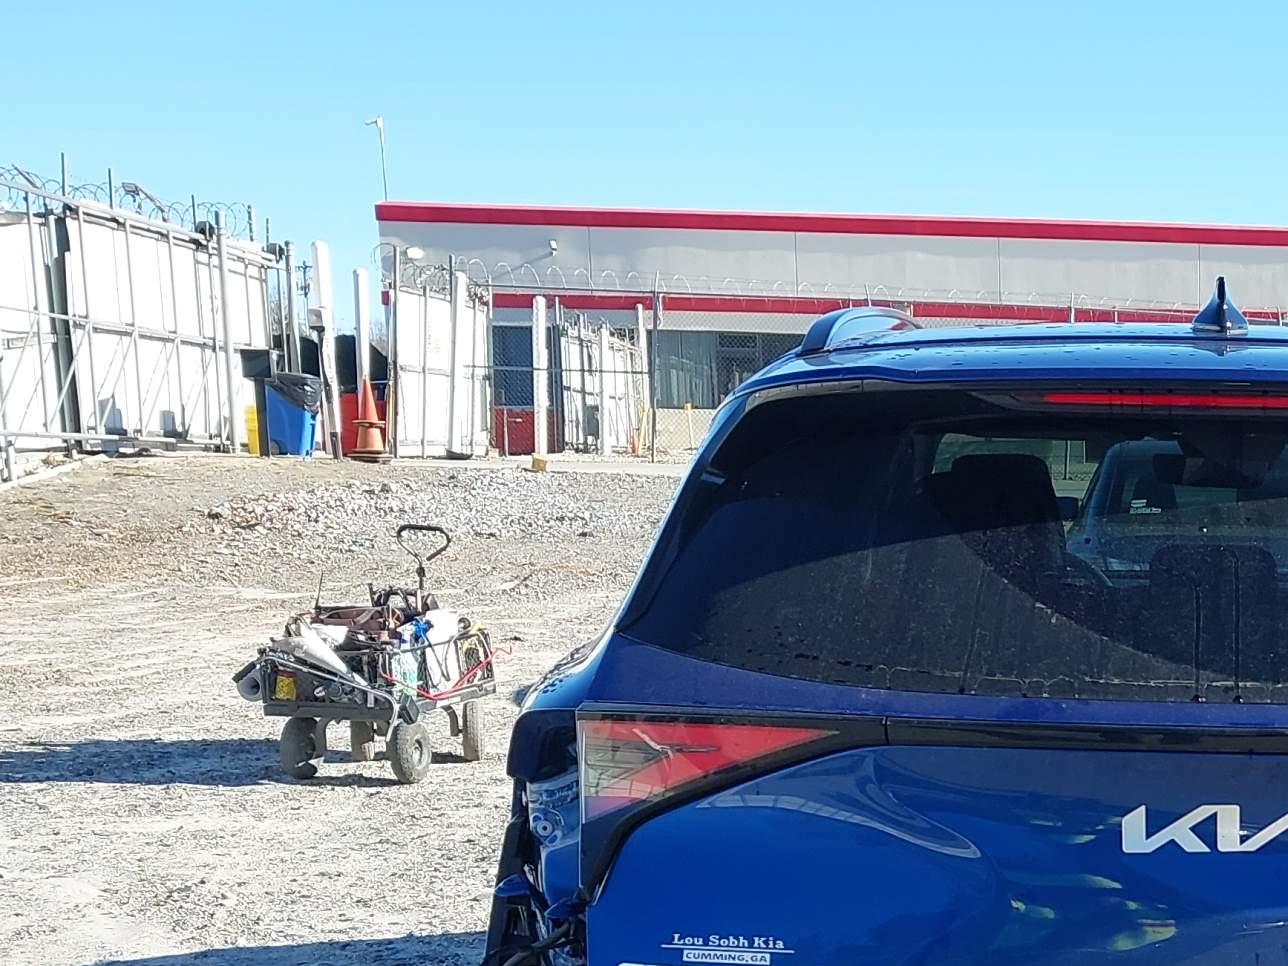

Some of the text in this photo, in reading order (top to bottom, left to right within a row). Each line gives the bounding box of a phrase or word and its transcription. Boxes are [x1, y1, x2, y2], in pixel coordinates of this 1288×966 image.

[671, 933, 785, 949] Lou Sobh Kia
